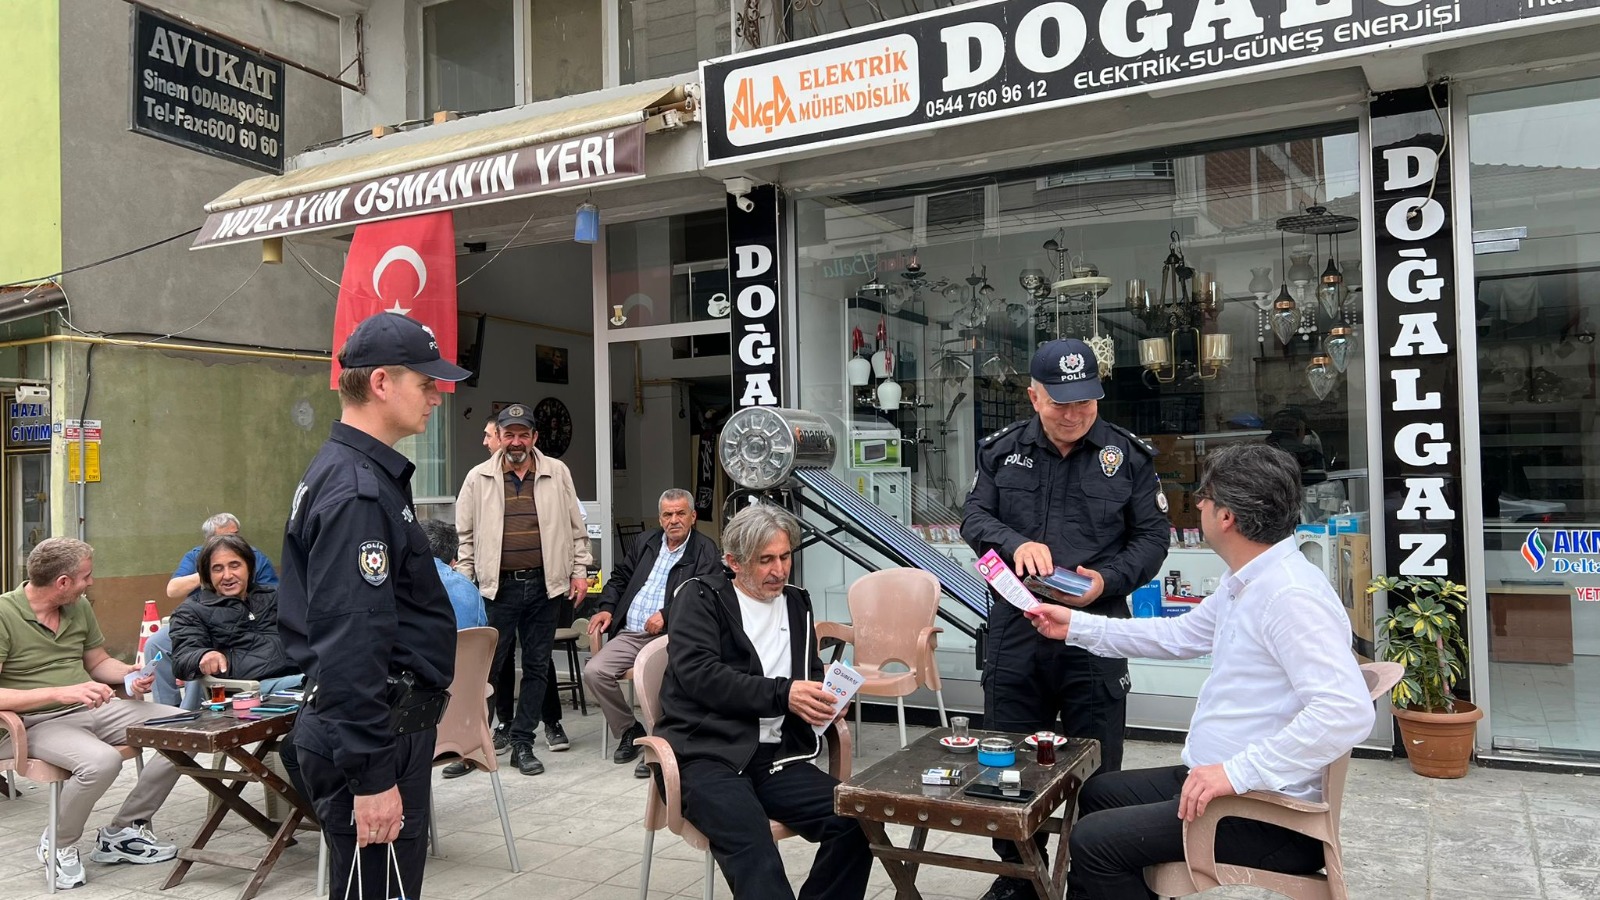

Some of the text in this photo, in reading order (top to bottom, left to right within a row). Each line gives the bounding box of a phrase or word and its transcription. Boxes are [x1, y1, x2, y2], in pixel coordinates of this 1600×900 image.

[148, 26, 276, 100] AVUKAT
[1073, 0, 1461, 90] ELEKTRİK-SU-GÜNEŞ ENERJİSİ
[799, 47, 908, 91] ELEKTRİK
[143, 69, 280, 133] Sinem ODABAŞOĞLU
[799, 78, 911, 122] MÜHENDİSLİK
[925, 80, 1047, 118] 0544 760 96 12
[143, 97, 278, 158] Tel-Fax:600 60 60
[354, 153, 519, 216] OSMAN'IN
[535, 132, 616, 186] YERİ
[1061, 372, 1087, 382] POLİS
[1382, 146, 1456, 577] DOĞALGAZ
[11, 422, 51, 442] GİYİM
[1004, 453, 1034, 469] POLİS
[361, 541, 384, 552] POLİS
